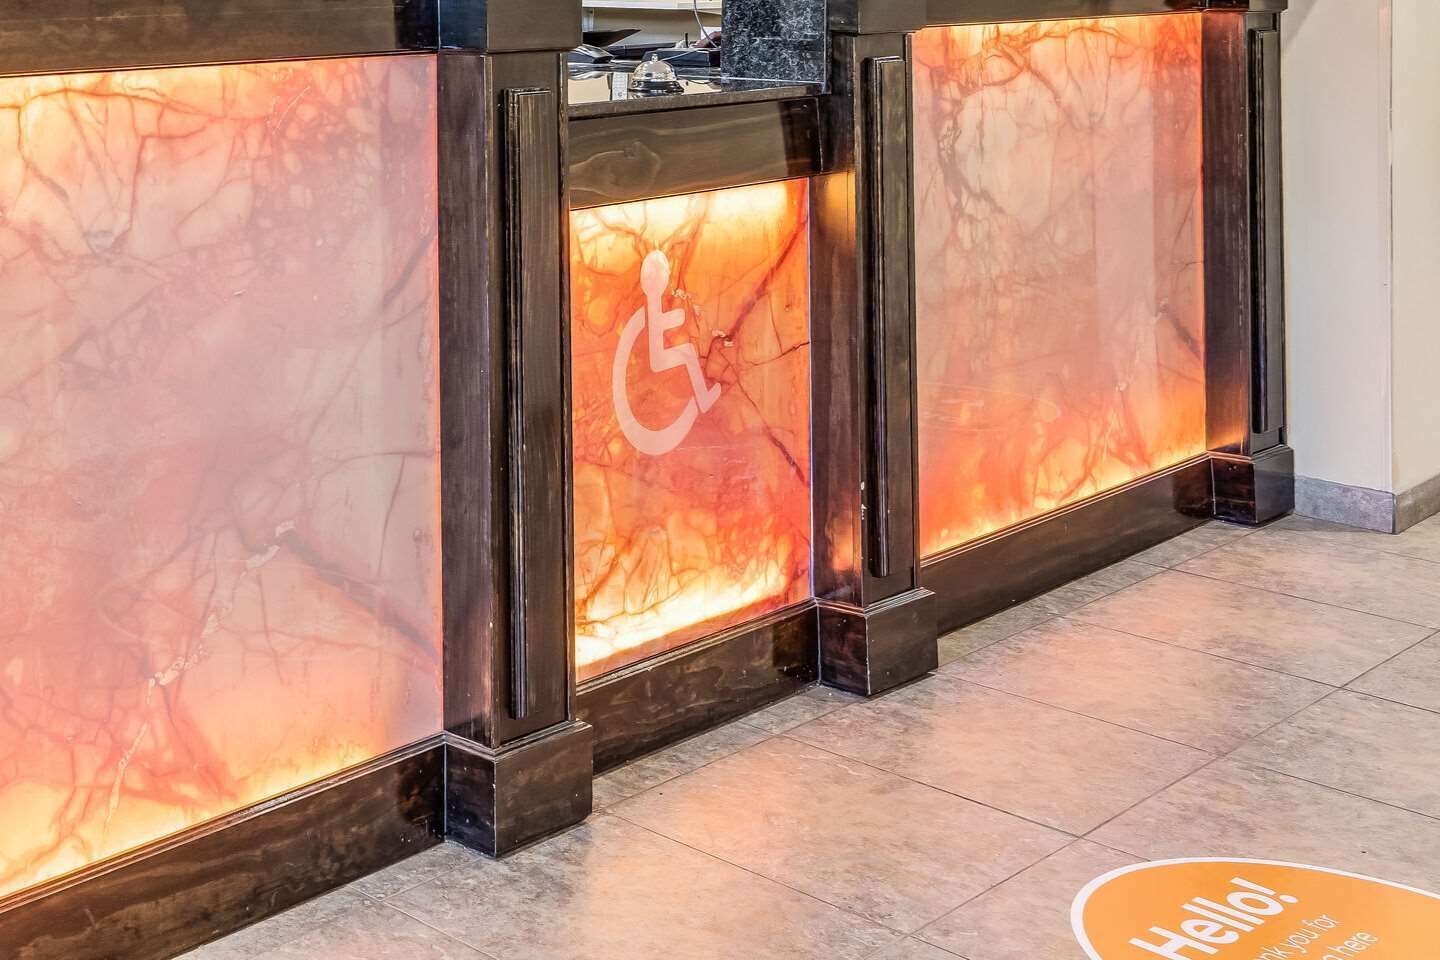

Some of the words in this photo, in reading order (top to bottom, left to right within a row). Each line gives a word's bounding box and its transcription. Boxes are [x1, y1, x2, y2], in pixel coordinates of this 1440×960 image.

[1128, 877, 1299, 960] Hello!
[1279, 927, 1320, 955] you
[1301, 914, 1340, 932] for
[1327, 932, 1379, 958] here
